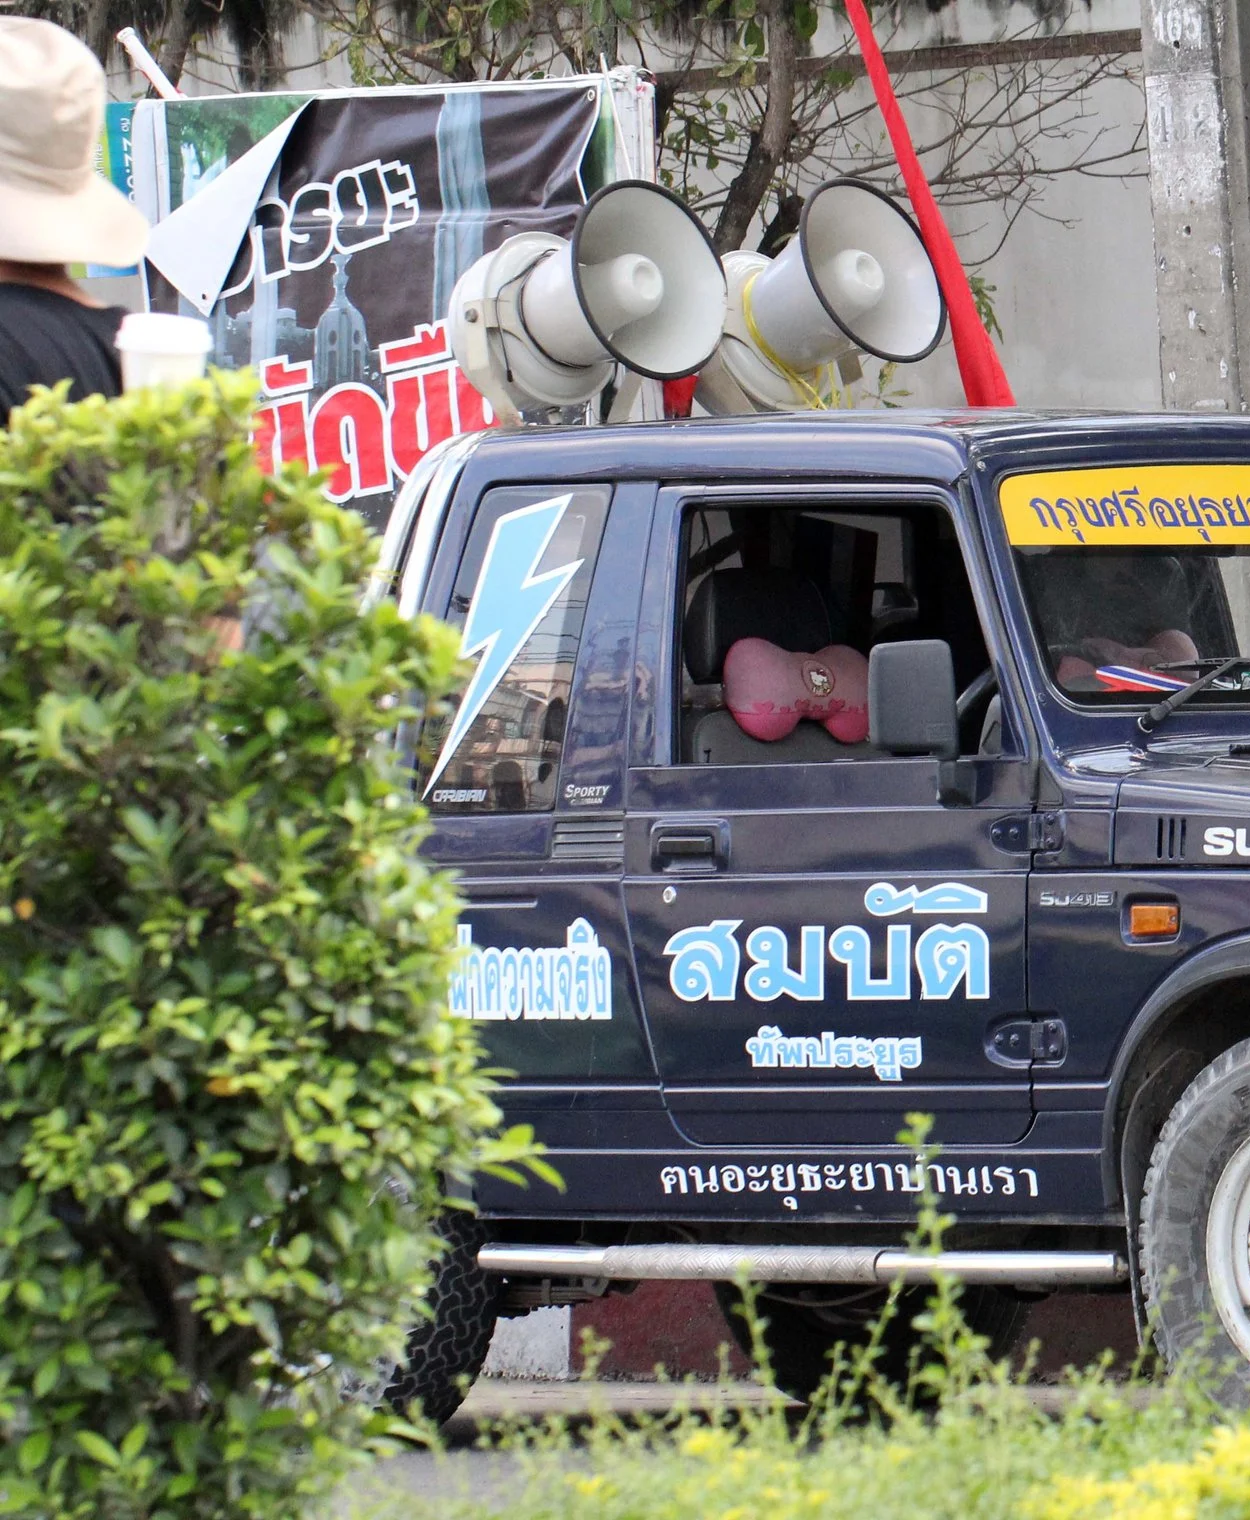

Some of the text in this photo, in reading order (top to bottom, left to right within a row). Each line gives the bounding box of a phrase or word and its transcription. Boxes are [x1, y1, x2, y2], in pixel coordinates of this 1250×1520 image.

[663, 882, 990, 1001] สมบัติ
[745, 1025, 922, 1081] ทัพประยูร
